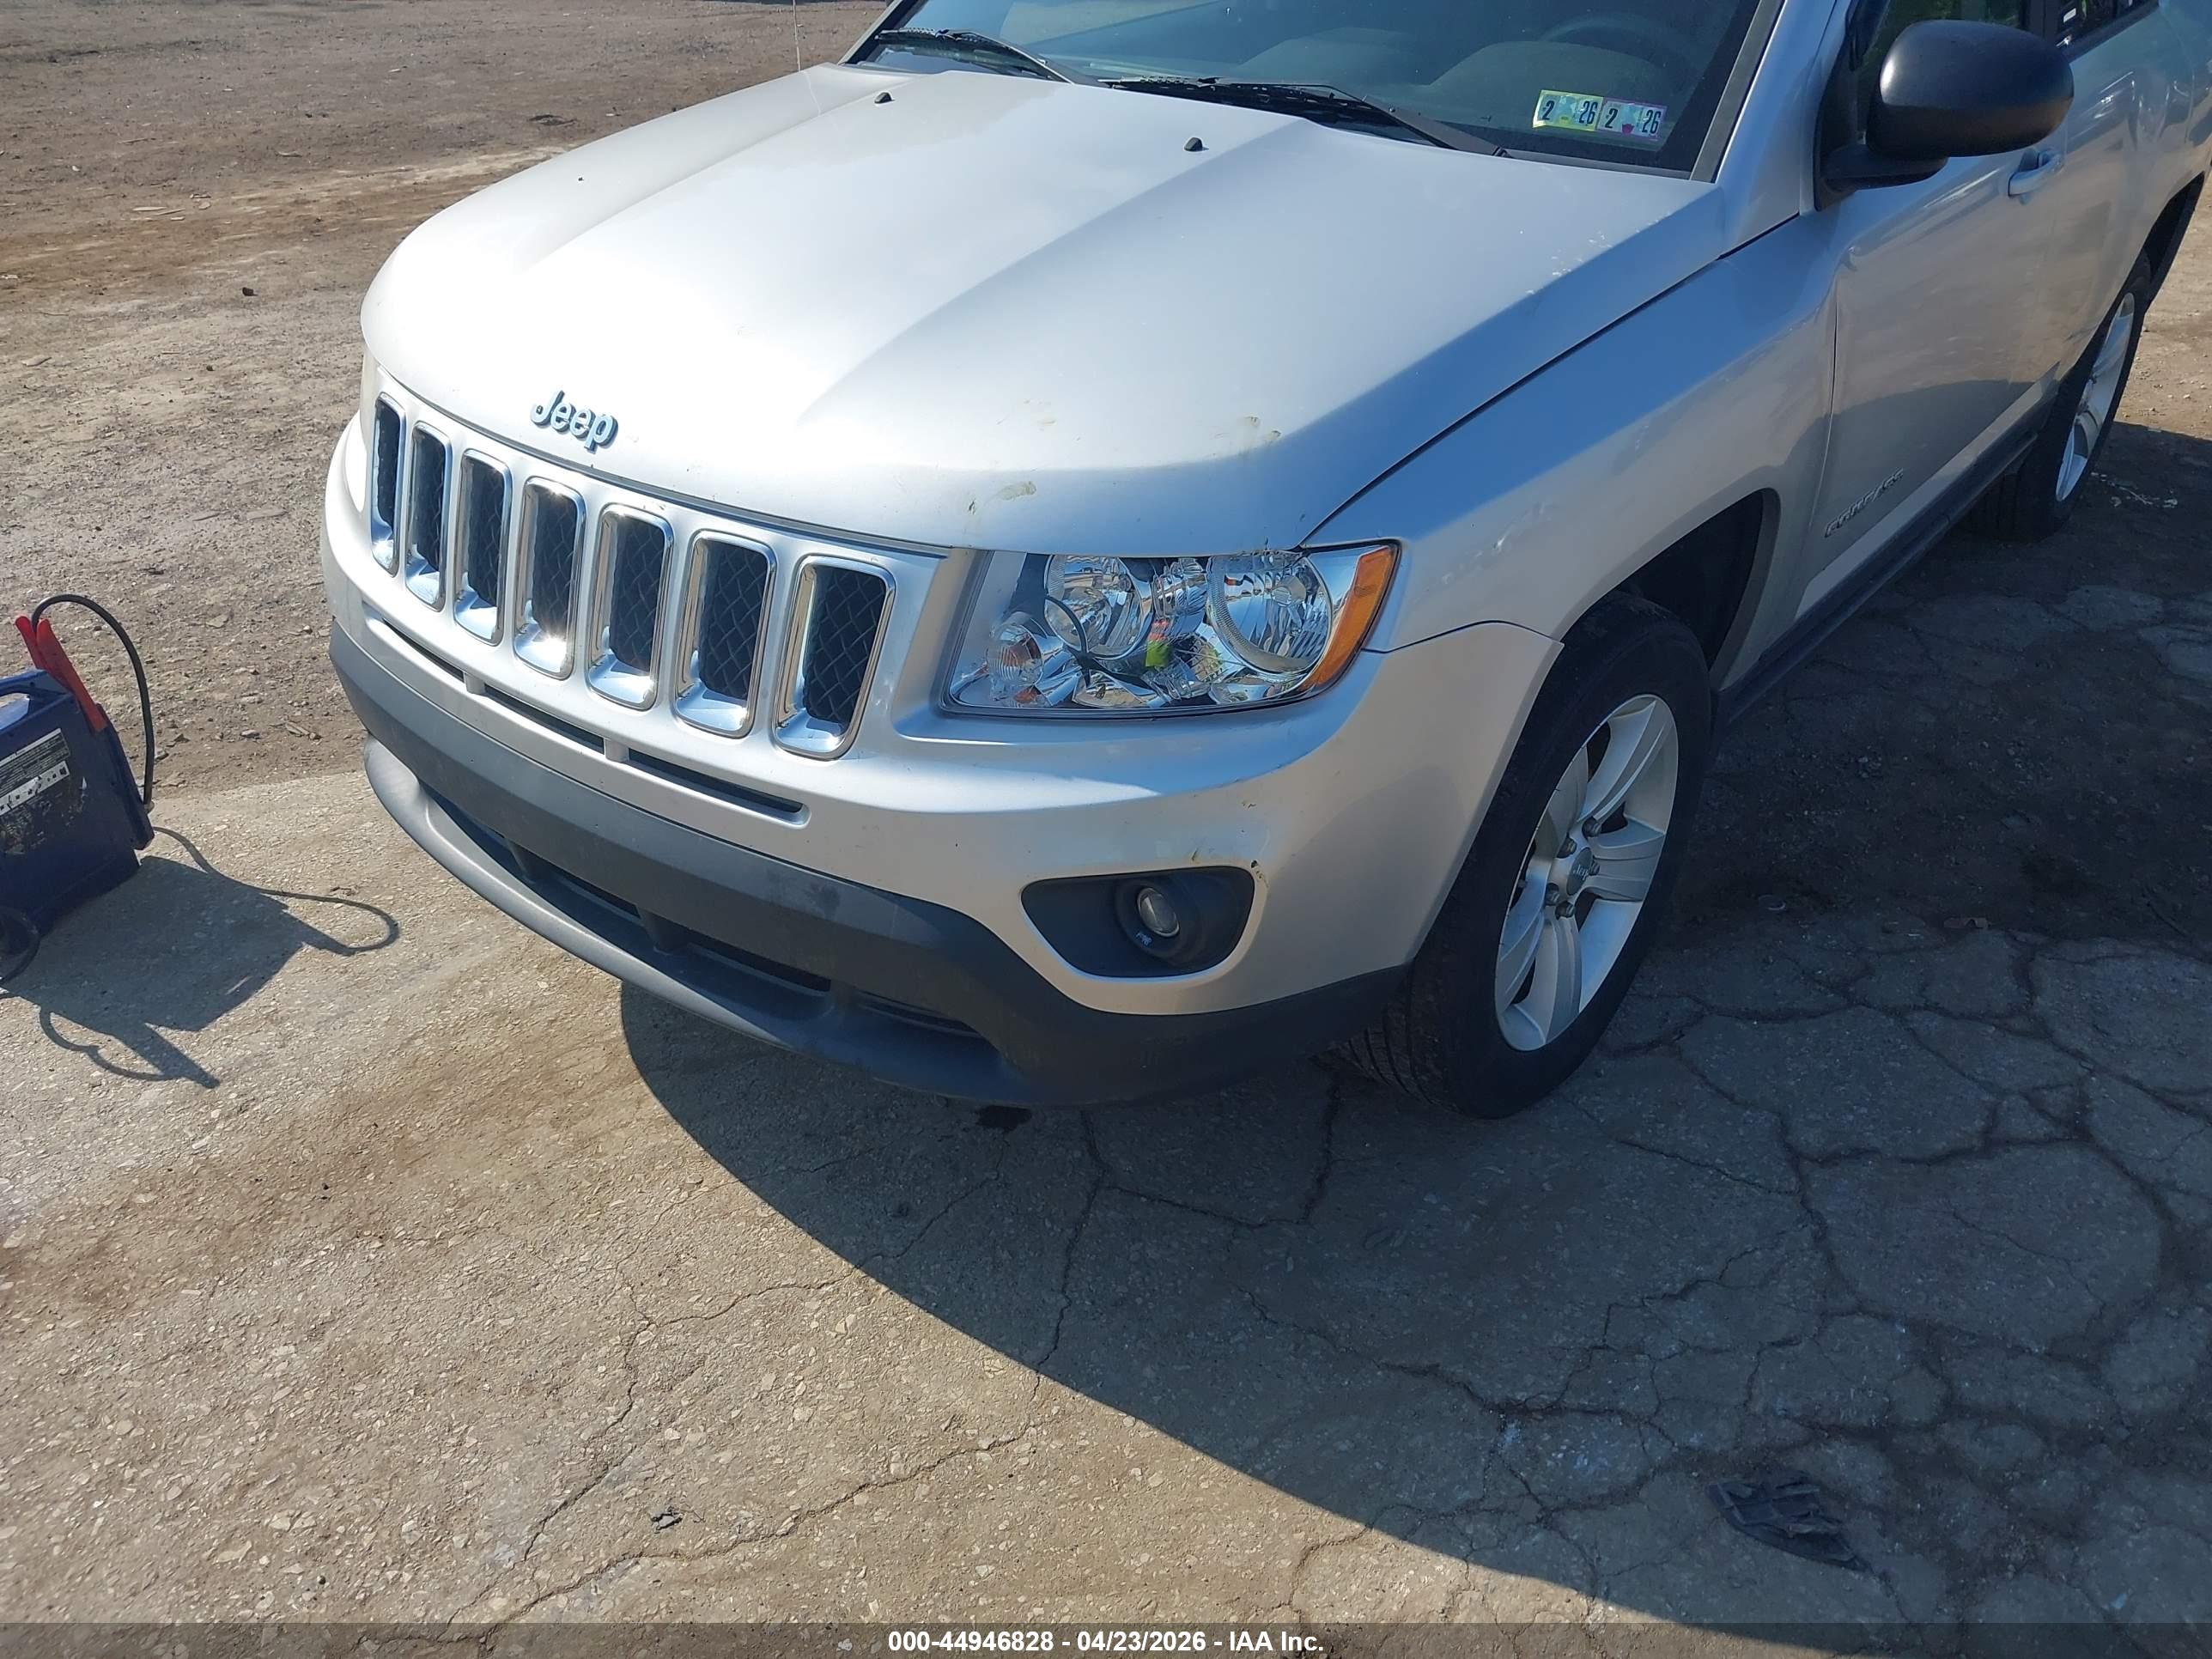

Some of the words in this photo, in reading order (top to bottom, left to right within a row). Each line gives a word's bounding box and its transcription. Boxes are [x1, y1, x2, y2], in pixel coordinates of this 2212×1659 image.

[1542, 100, 1555, 120] 2
[1579, 100, 1598, 125] 26
[1605, 108, 1619, 129] 2
[1642, 109, 1662, 134] 26
[530, 390, 619, 454] Jeep
